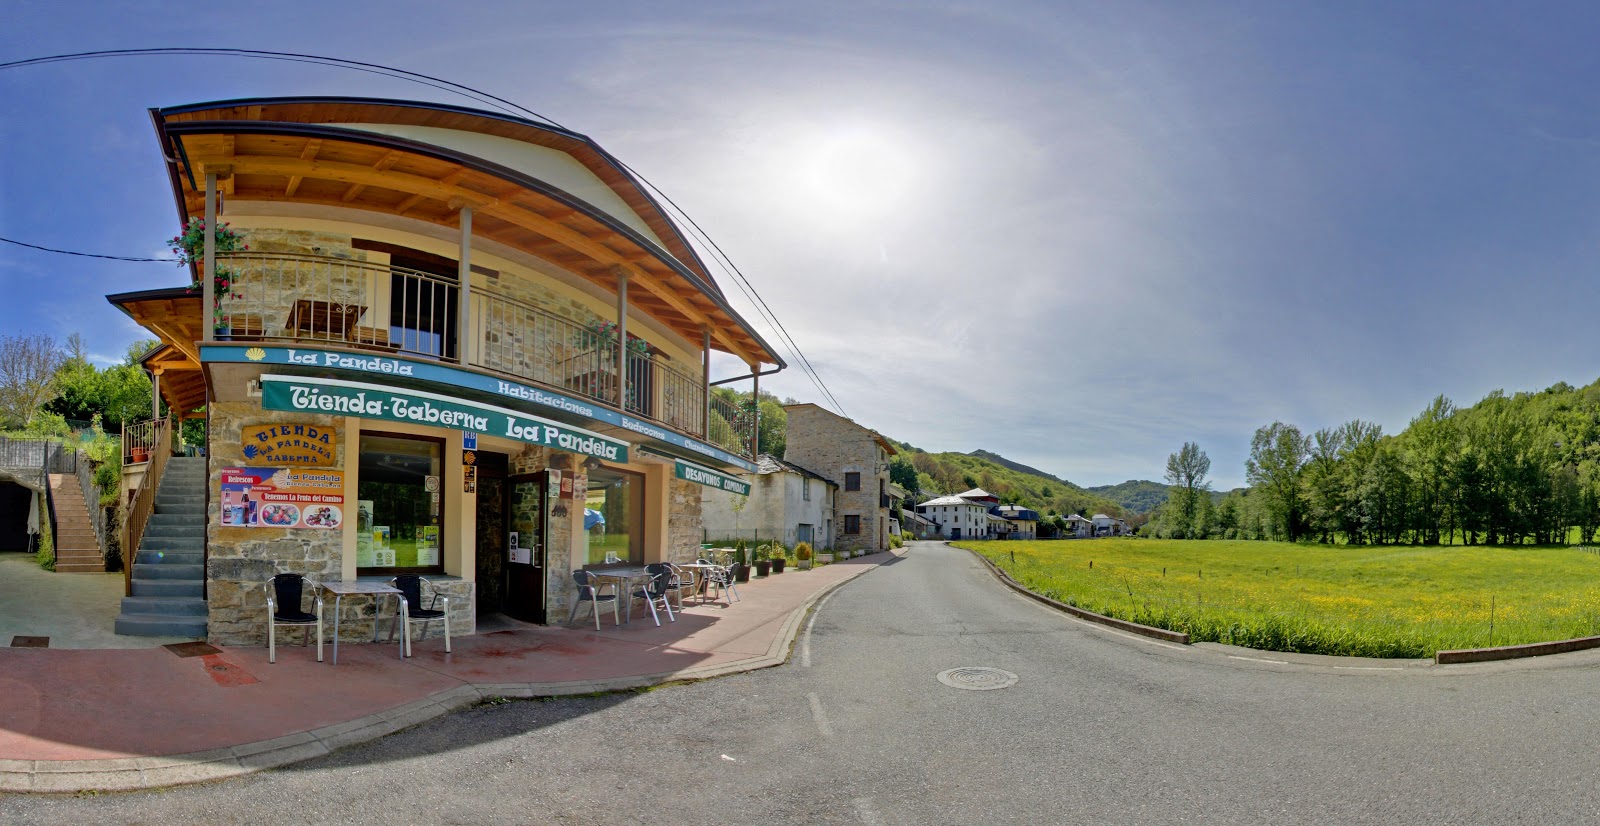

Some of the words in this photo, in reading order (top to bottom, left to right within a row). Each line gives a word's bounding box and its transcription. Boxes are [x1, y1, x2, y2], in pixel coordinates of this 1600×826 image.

[287, 349, 318, 365] La
[324, 352, 413, 376] Pandela
[498, 381, 593, 417] Habitaciones
[256, 425, 330, 444] TIENDA
[465, 431, 476, 440] RB
[506, 416, 539, 442] La
[543, 425, 617, 460] Pandela
[622, 417, 665, 440] Bedrooms
[259, 446, 274, 456] LA
[276, 440, 331, 459] PANDELA
[684, 440, 715, 457] Chambres
[266, 454, 318, 463] TABERNA
[685, 466, 720, 488] DESAYUNOS
[723, 479, 746, 494] COMIDAS
[264, 493, 288, 501] Tenemos
[289, 493, 296, 501] La
[297, 494, 312, 502] Fruta
[312, 494, 322, 502] del
[322, 495, 342, 503] Camino
